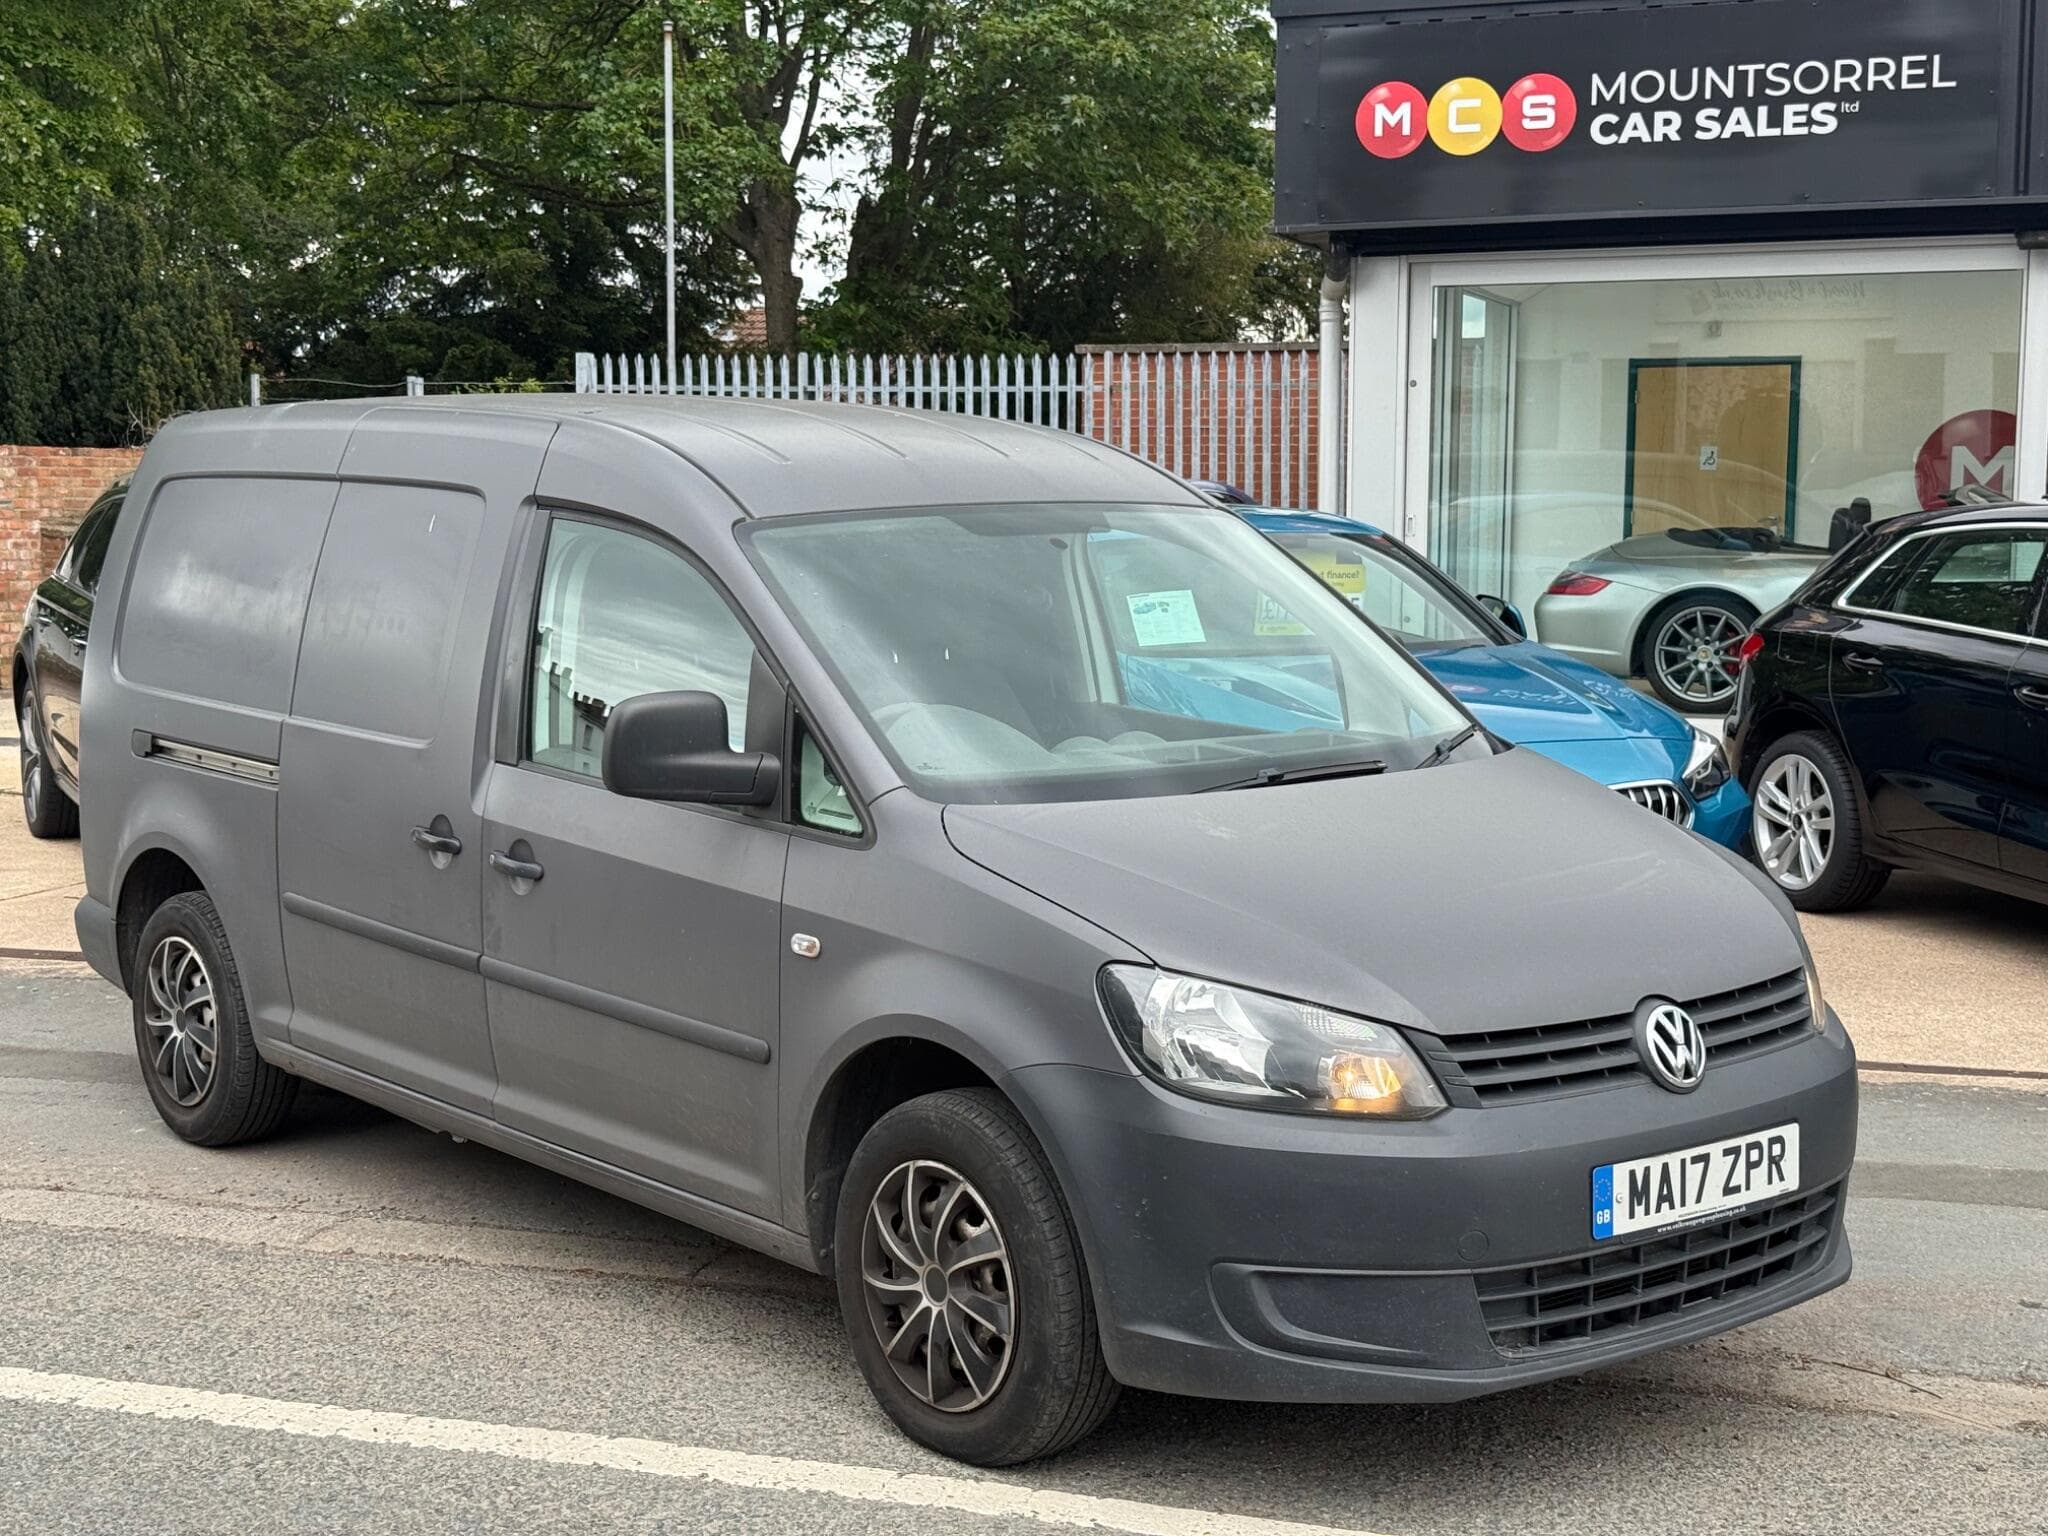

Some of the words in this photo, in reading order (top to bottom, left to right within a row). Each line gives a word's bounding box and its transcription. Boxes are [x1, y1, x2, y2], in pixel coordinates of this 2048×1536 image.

[1591, 54, 1957, 106] MOUNTSORREL
[1590, 111, 1682, 145] CAR
[1694, 102, 1838, 140] SALES
[1841, 101, 1860, 113] ltd
[1950, 445, 2015, 501] M
[1628, 1152, 1711, 1219] MA17
[1722, 1135, 1786, 1197] ZPR
[1596, 1208, 1611, 1225] GB
